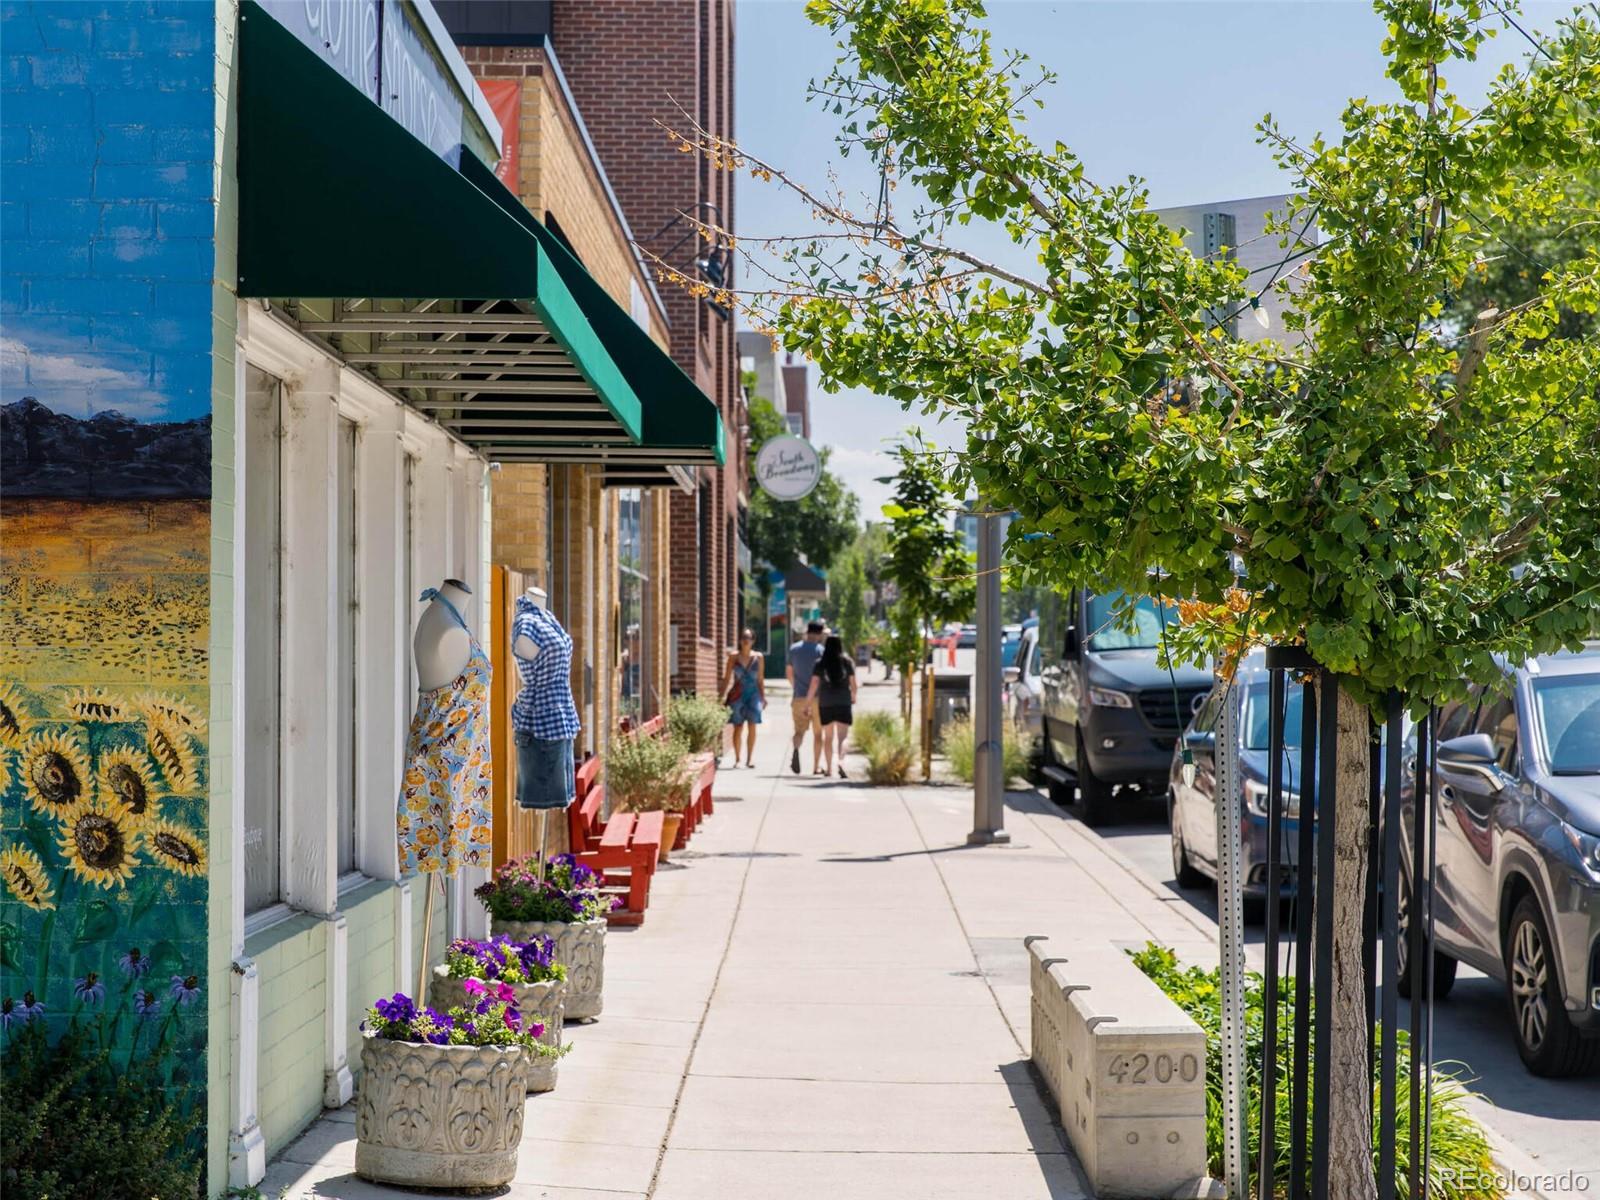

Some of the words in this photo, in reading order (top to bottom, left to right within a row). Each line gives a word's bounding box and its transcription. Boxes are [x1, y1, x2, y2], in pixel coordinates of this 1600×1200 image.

[772, 450, 804, 466] South
[761, 463, 815, 479] Broadway
[1109, 1053, 1198, 1083] 4200
